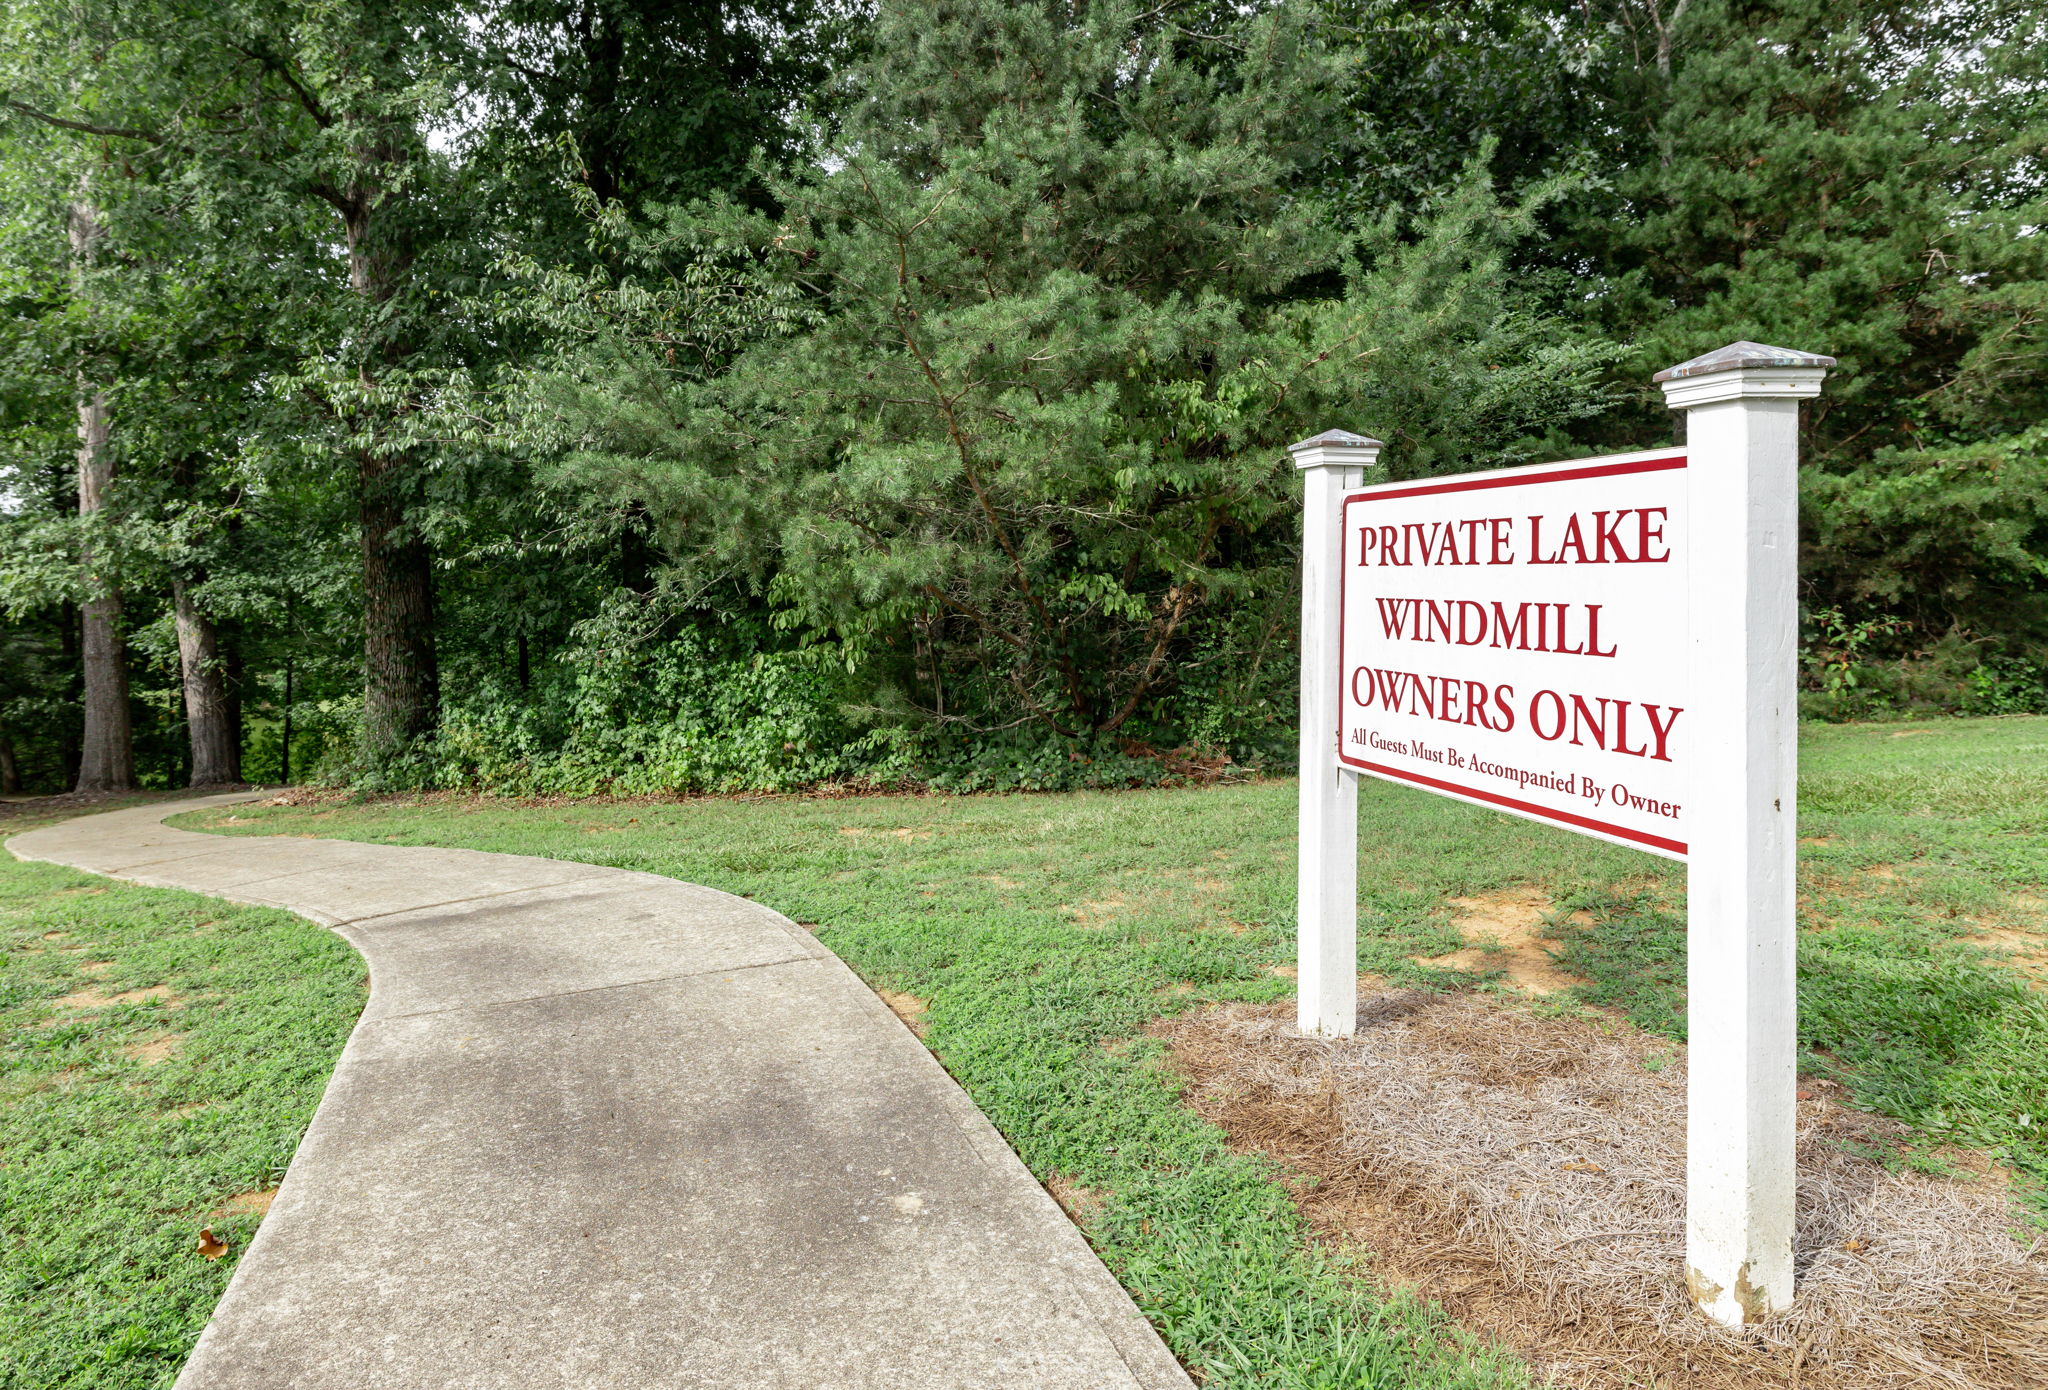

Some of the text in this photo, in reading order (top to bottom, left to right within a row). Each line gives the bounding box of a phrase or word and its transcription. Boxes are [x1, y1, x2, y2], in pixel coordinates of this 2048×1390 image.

[1358, 507, 1671, 567] PRIVATE LAKE
[1376, 597, 1617, 658] WINDMILL
[1352, 666, 1684, 762] OWNERS ONLY
[1351, 728, 1681, 819] All Guests Must Be Accompanied By Owner
